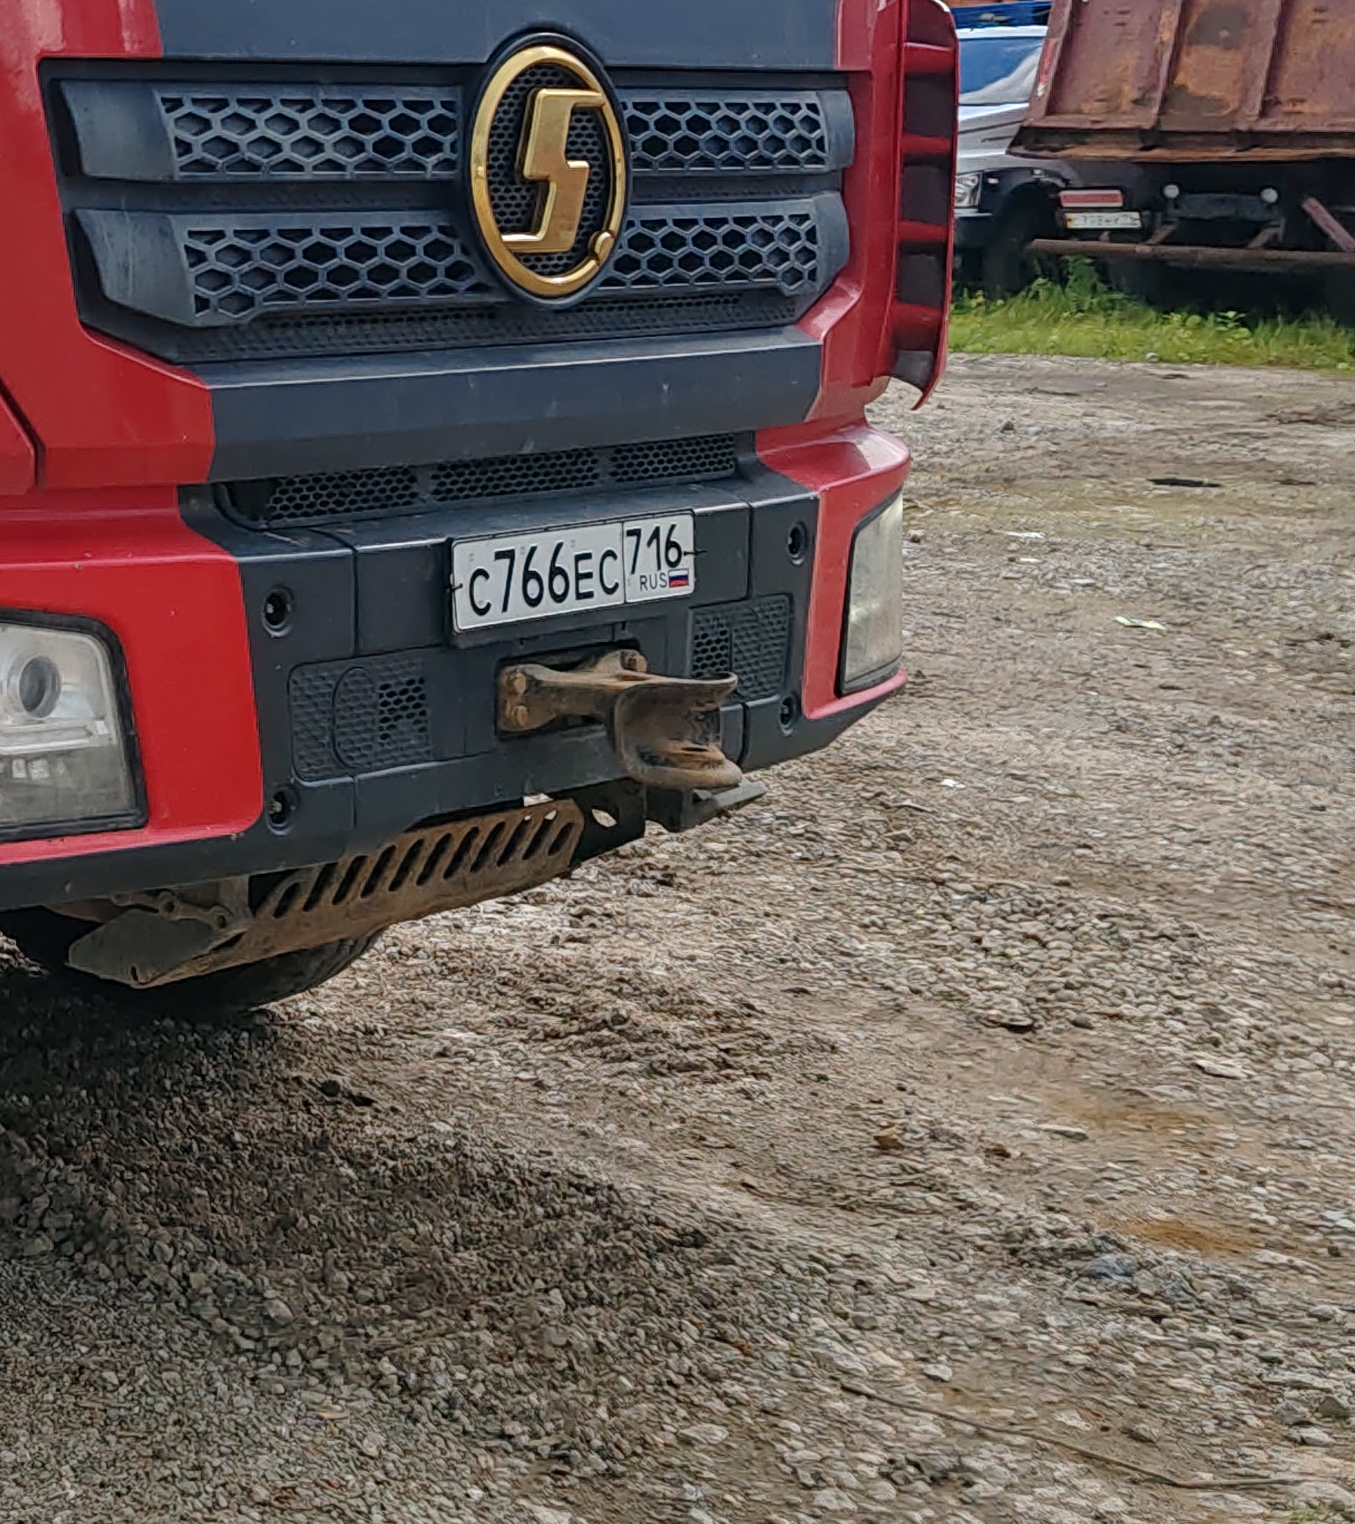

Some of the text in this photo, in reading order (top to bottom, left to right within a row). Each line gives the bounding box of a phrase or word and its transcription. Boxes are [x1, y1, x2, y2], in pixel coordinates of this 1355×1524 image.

[468, 524, 683, 616] С766ЕС 716
[639, 572, 668, 592] RUS
